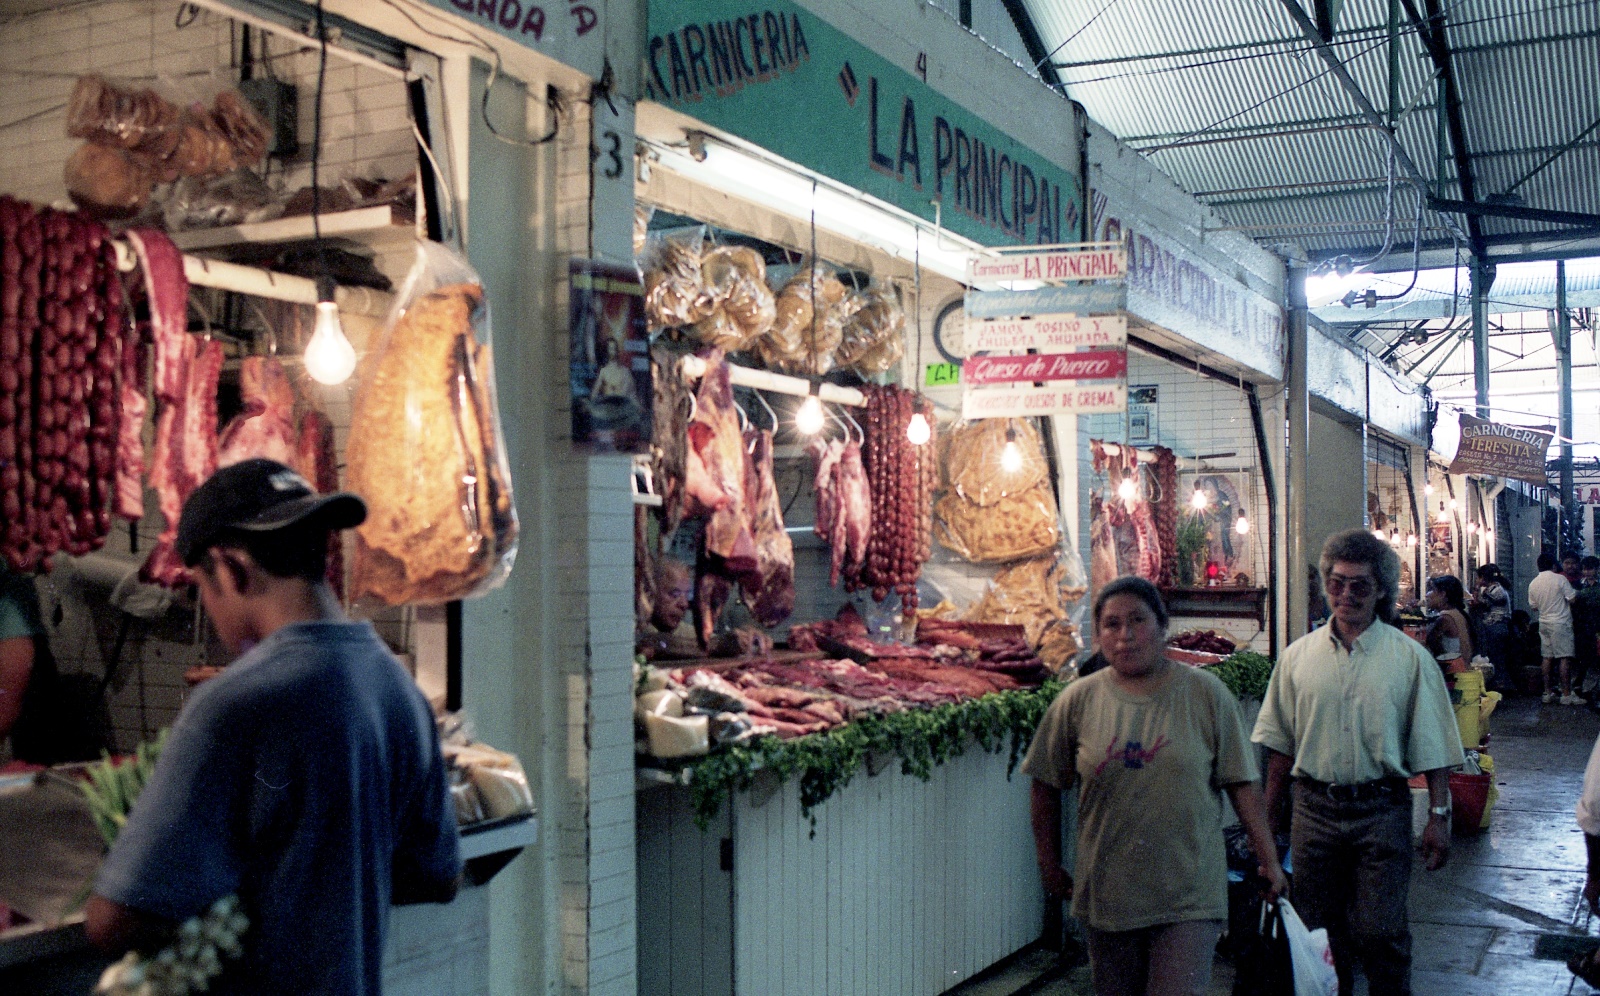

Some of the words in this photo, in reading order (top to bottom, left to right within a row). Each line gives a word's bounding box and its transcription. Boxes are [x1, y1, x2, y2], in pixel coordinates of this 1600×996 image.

[650, 10, 811, 105] CARNICERIA
[603, 131, 622, 178] 3
[1024, 257, 1041, 279] LA
[1093, 320, 1103, 331] Y
[973, 359, 1023, 382] Queso
[1023, 357, 1045, 377] de
[1047, 356, 1110, 376] Puerco
[1062, 394, 1072, 408] DE
[1077, 391, 1115, 407] CREMA
[1463, 424, 1544, 449] CARNICERIA
